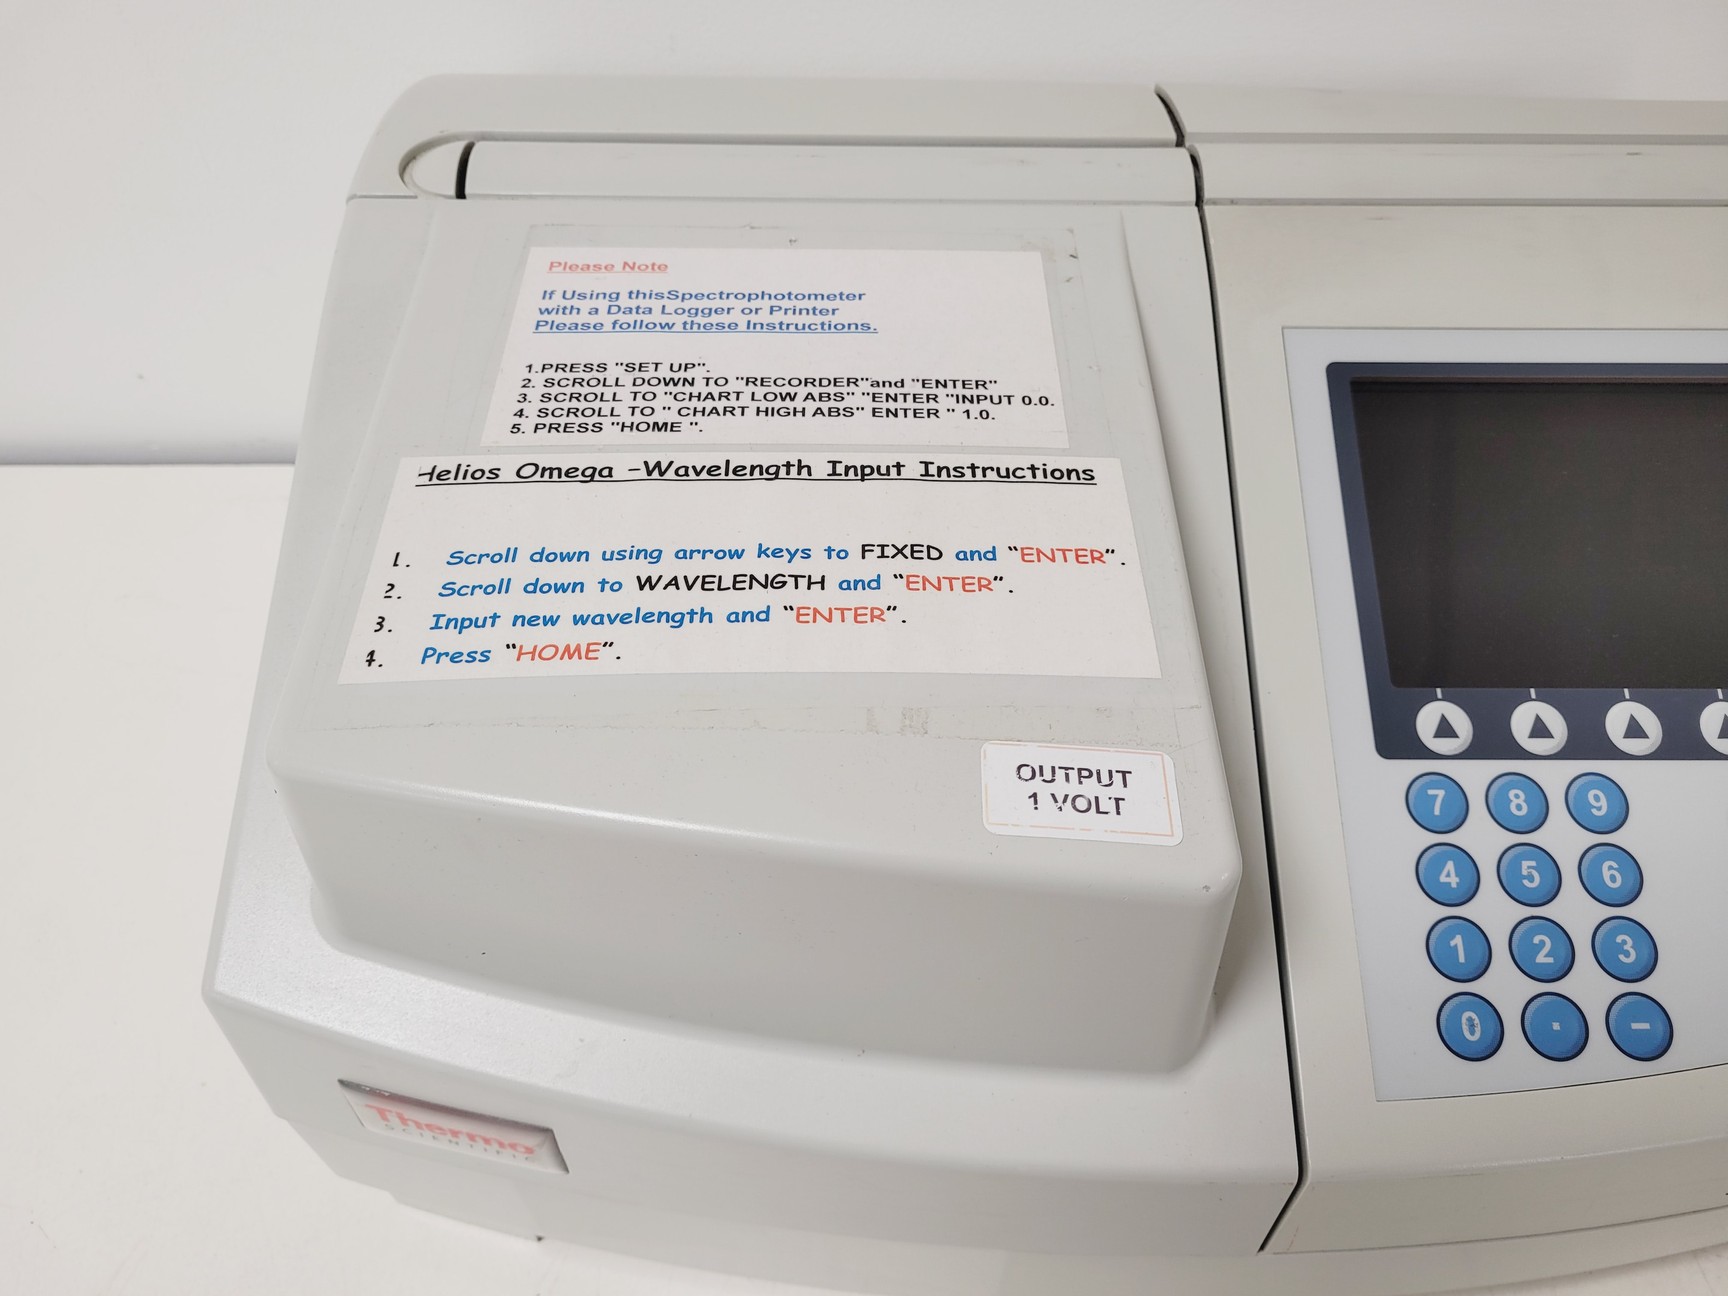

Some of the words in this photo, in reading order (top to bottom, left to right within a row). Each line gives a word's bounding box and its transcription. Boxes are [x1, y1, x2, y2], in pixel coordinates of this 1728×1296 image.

[549, 260, 615, 272] Please
[622, 260, 668, 272] Note
[542, 290, 558, 300] If
[562, 290, 621, 302] Using
[538, 305, 581, 316] with
[607, 305, 653, 316] Data
[661, 305, 736, 318] Logger
[741, 308, 762, 316] or
[769, 306, 840, 316] Printer
[534, 320, 604, 331] Please
[612, 320, 676, 331] follow
[682, 320, 738, 331] these
[746, 320, 878, 332] Instructions.
[615, 362, 663, 373] "SET
[670, 362, 710, 373] UP".
[521, 378, 536, 389] 2.
[543, 377, 626, 388] SCROLL
[632, 377, 696, 387] DOWN
[702, 377, 729, 387] TO
[912, 379, 998, 390] "ENTER"
[517, 392, 532, 404] 3.
[540, 392, 623, 402] SCROLL
[629, 392, 657, 402] TO
[664, 392, 744, 402] "CHART
[750, 392, 798, 402] LOW
[803, 392, 855, 402] ABS"
[1022, 396, 1055, 406] 0.0.
[513, 408, 530, 418] 4.
[537, 407, 621, 418] SCROLL
[628, 406, 656, 417] TO
[677, 406, 749, 417] CHART
[756, 406, 806, 417] HIGH
[812, 406, 865, 418] ABS"
[872, 408, 941, 418] ENTER
[962, 409, 996, 420] 1.0.
[510, 424, 526, 434] 5.
[534, 422, 604, 433] PRESS
[611, 422, 682, 432] "HOME
[516, 462, 614, 483] Omega
[826, 460, 906, 482] Input
[920, 460, 1096, 481] Instructions
[392, 552, 411, 568] 1.
[446, 547, 518, 566] Scroll
[529, 548, 590, 564] down
[601, 545, 662, 564] using
[674, 547, 746, 562] arrow
[757, 543, 812, 563] keys
[824, 546, 850, 560] to
[860, 544, 944, 561] FIXED
[955, 545, 998, 562] and
[384, 583, 402, 600] 2.
[438, 578, 512, 598] Scroll
[523, 578, 585, 594] down
[597, 578, 623, 594] to
[636, 574, 826, 592] WAVELENGTH
[838, 574, 882, 592] and
[374, 616, 393, 632] 3.
[429, 612, 500, 635] Input
[512, 614, 560, 627] new
[572, 607, 714, 628] wavelength
[726, 605, 770, 624] and
[365, 650, 384, 668] 4.
[420, 647, 492, 664] Press
[1016, 764, 1132, 788] OUTPUT
[1028, 792, 1038, 810] 1
[1050, 792, 1126, 816] VOLT
[1427, 788, 1446, 816] 7
[1508, 788, 1528, 816] 8
[1588, 788, 1608, 816] 9
[1439, 860, 1460, 888] 4
[1520, 860, 1541, 888] 5
[1602, 860, 1622, 888] 6
[1450, 934, 1466, 964] 1
[1532, 934, 1554, 964] 2
[1616, 934, 1637, 964] 3
[1461, 1010, 1480, 1042] 0
[365, 1104, 535, 1154] Thermo
